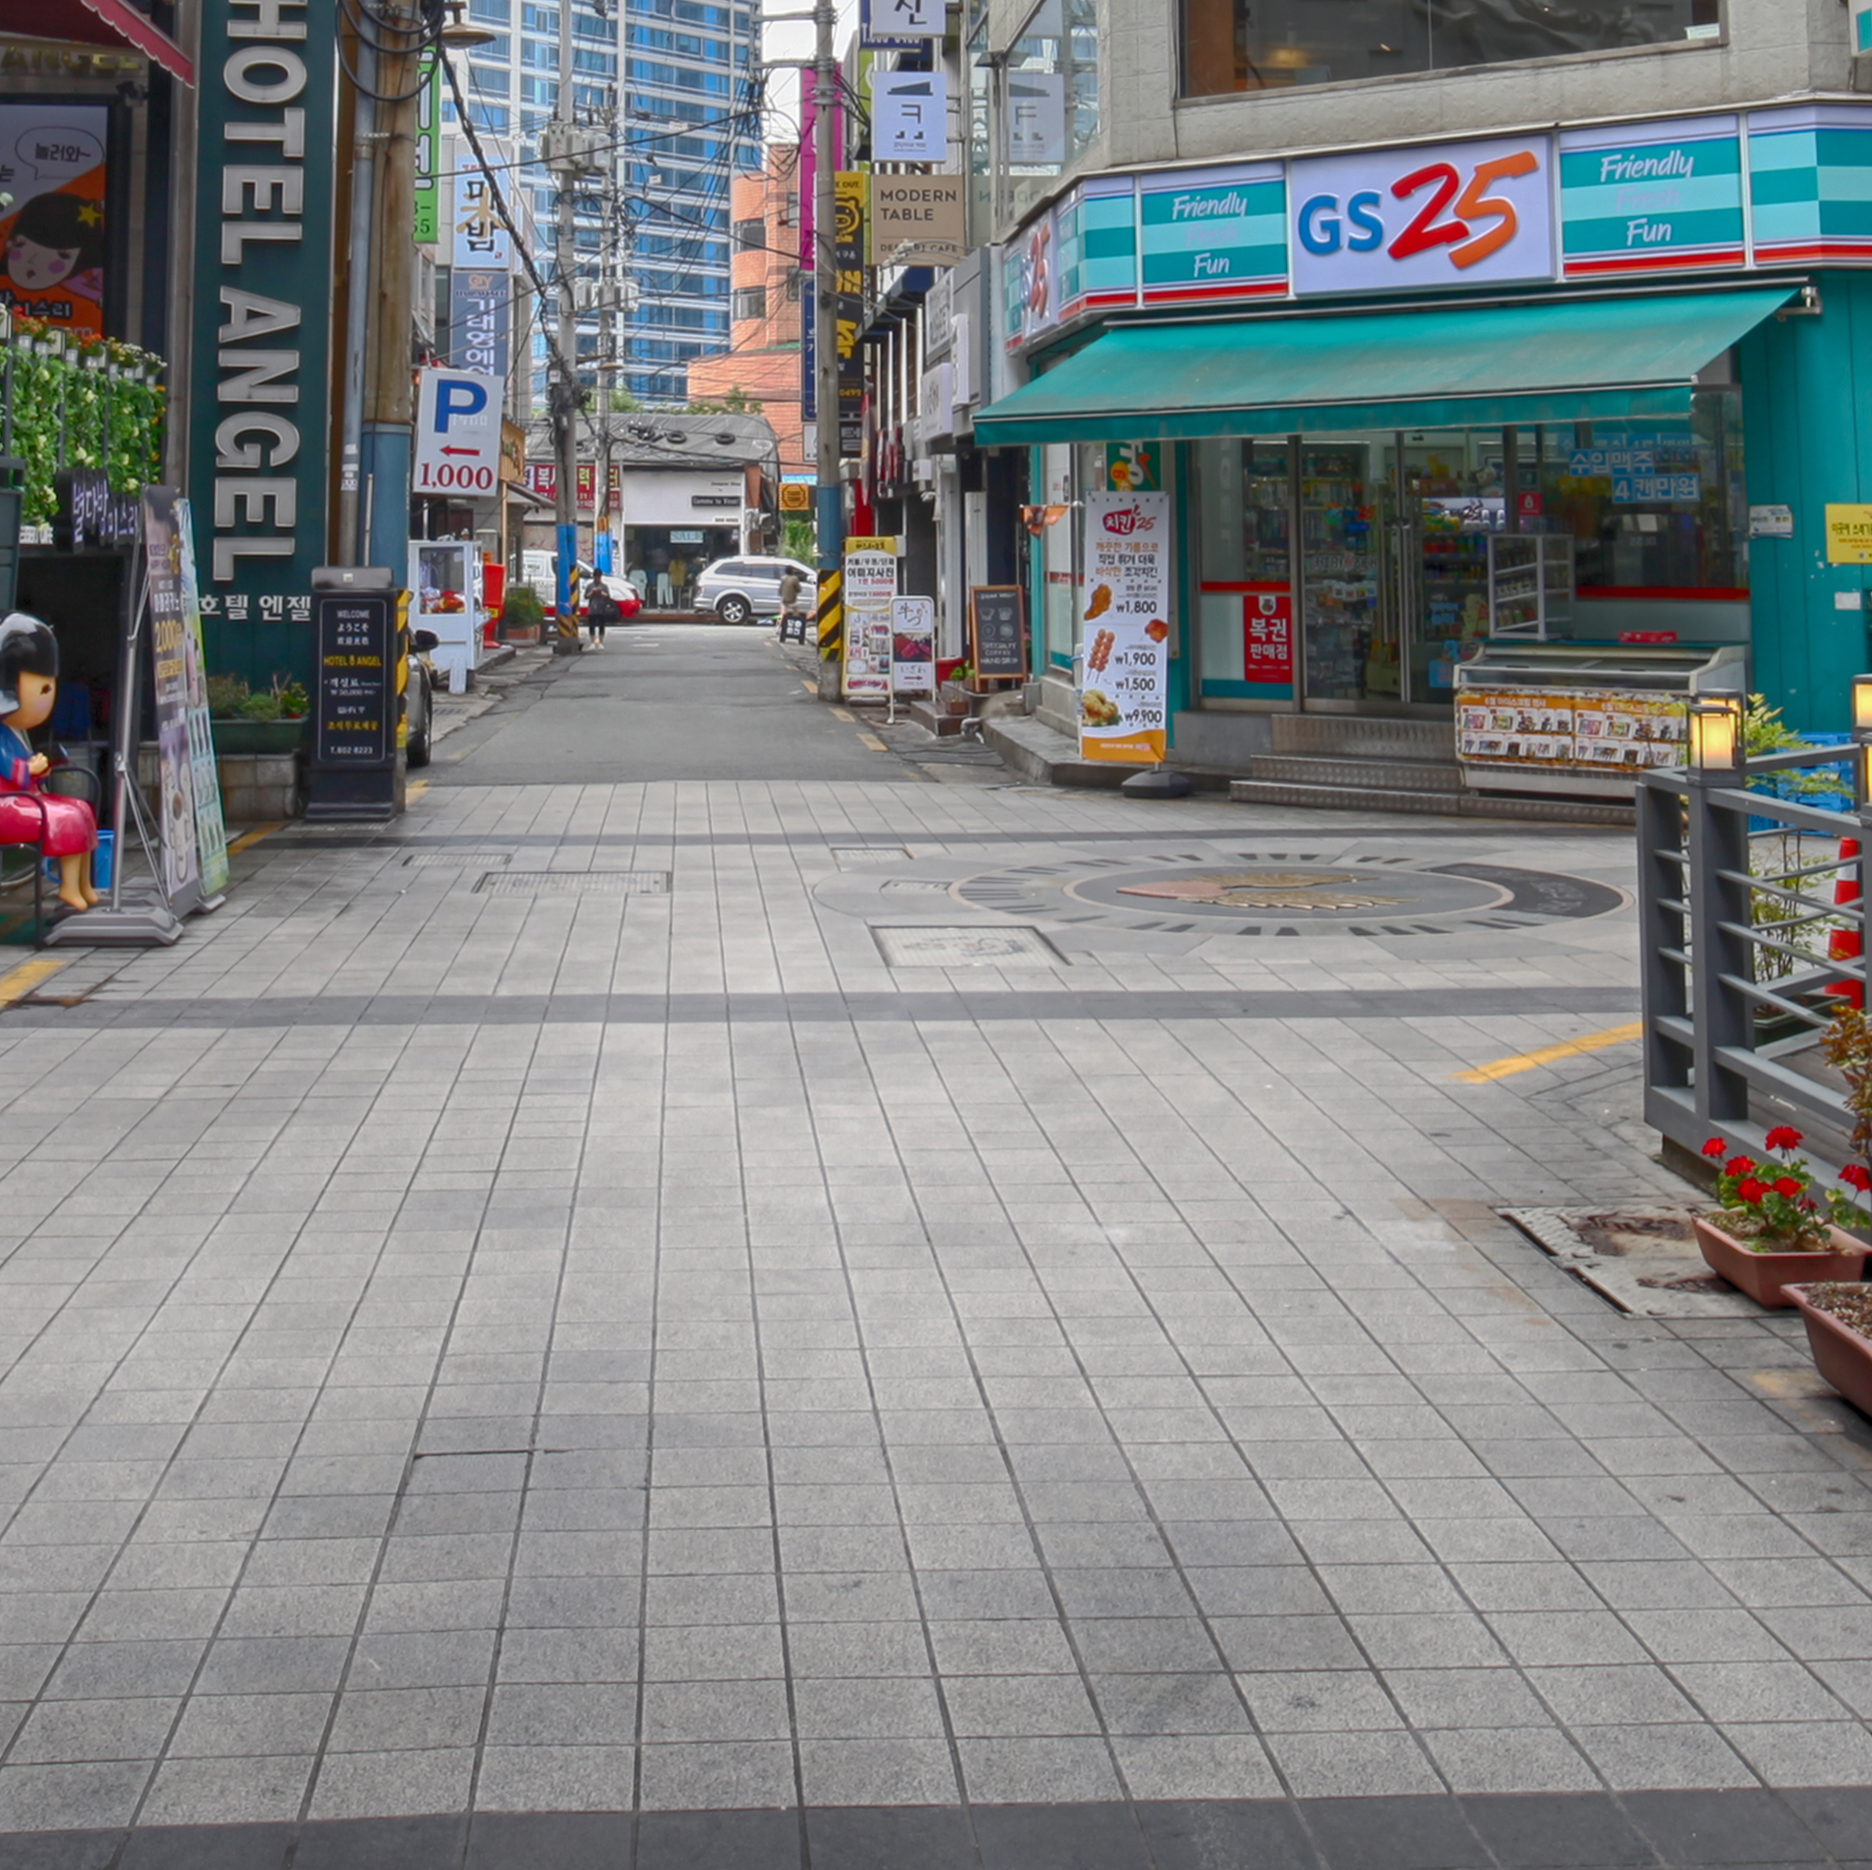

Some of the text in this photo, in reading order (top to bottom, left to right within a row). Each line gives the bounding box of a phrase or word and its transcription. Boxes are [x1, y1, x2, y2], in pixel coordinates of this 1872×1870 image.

[1599, 149, 1695, 184] Friendly
[880, 189, 957, 202] MODERN
[1172, 191, 1248, 221] Friendly
[880, 208, 934, 221] TABLE
[1298, 150, 1539, 270] GS25
[1626, 219, 1672, 246] Fun
[1193, 254, 1230, 278] Fun
[434, 379, 488, 433] P
[213, 286, 301, 581] ANGEL
[1569, 450, 1654, 475] 수입맥주
[418, 463, 494, 491] 1,000
[1105, 513, 1157, 533] 치킨 25
[670, 531, 703, 542] SALE
[1124, 541, 1159, 553] 기름으로
[1098, 554, 1116, 565] 직접
[847, 567, 895, 578] 이미지사진
[1095, 566, 1158, 578] 바삭한 조각치킨
[198, 592, 313, 622] 호텔 엔젤
[336, 609, 371, 620] WELCOME
[1249, 617, 1288, 642] 복권
[323, 655, 382, 667] HOTEL ANGEL
[1250, 643, 1288, 660] 판매점
